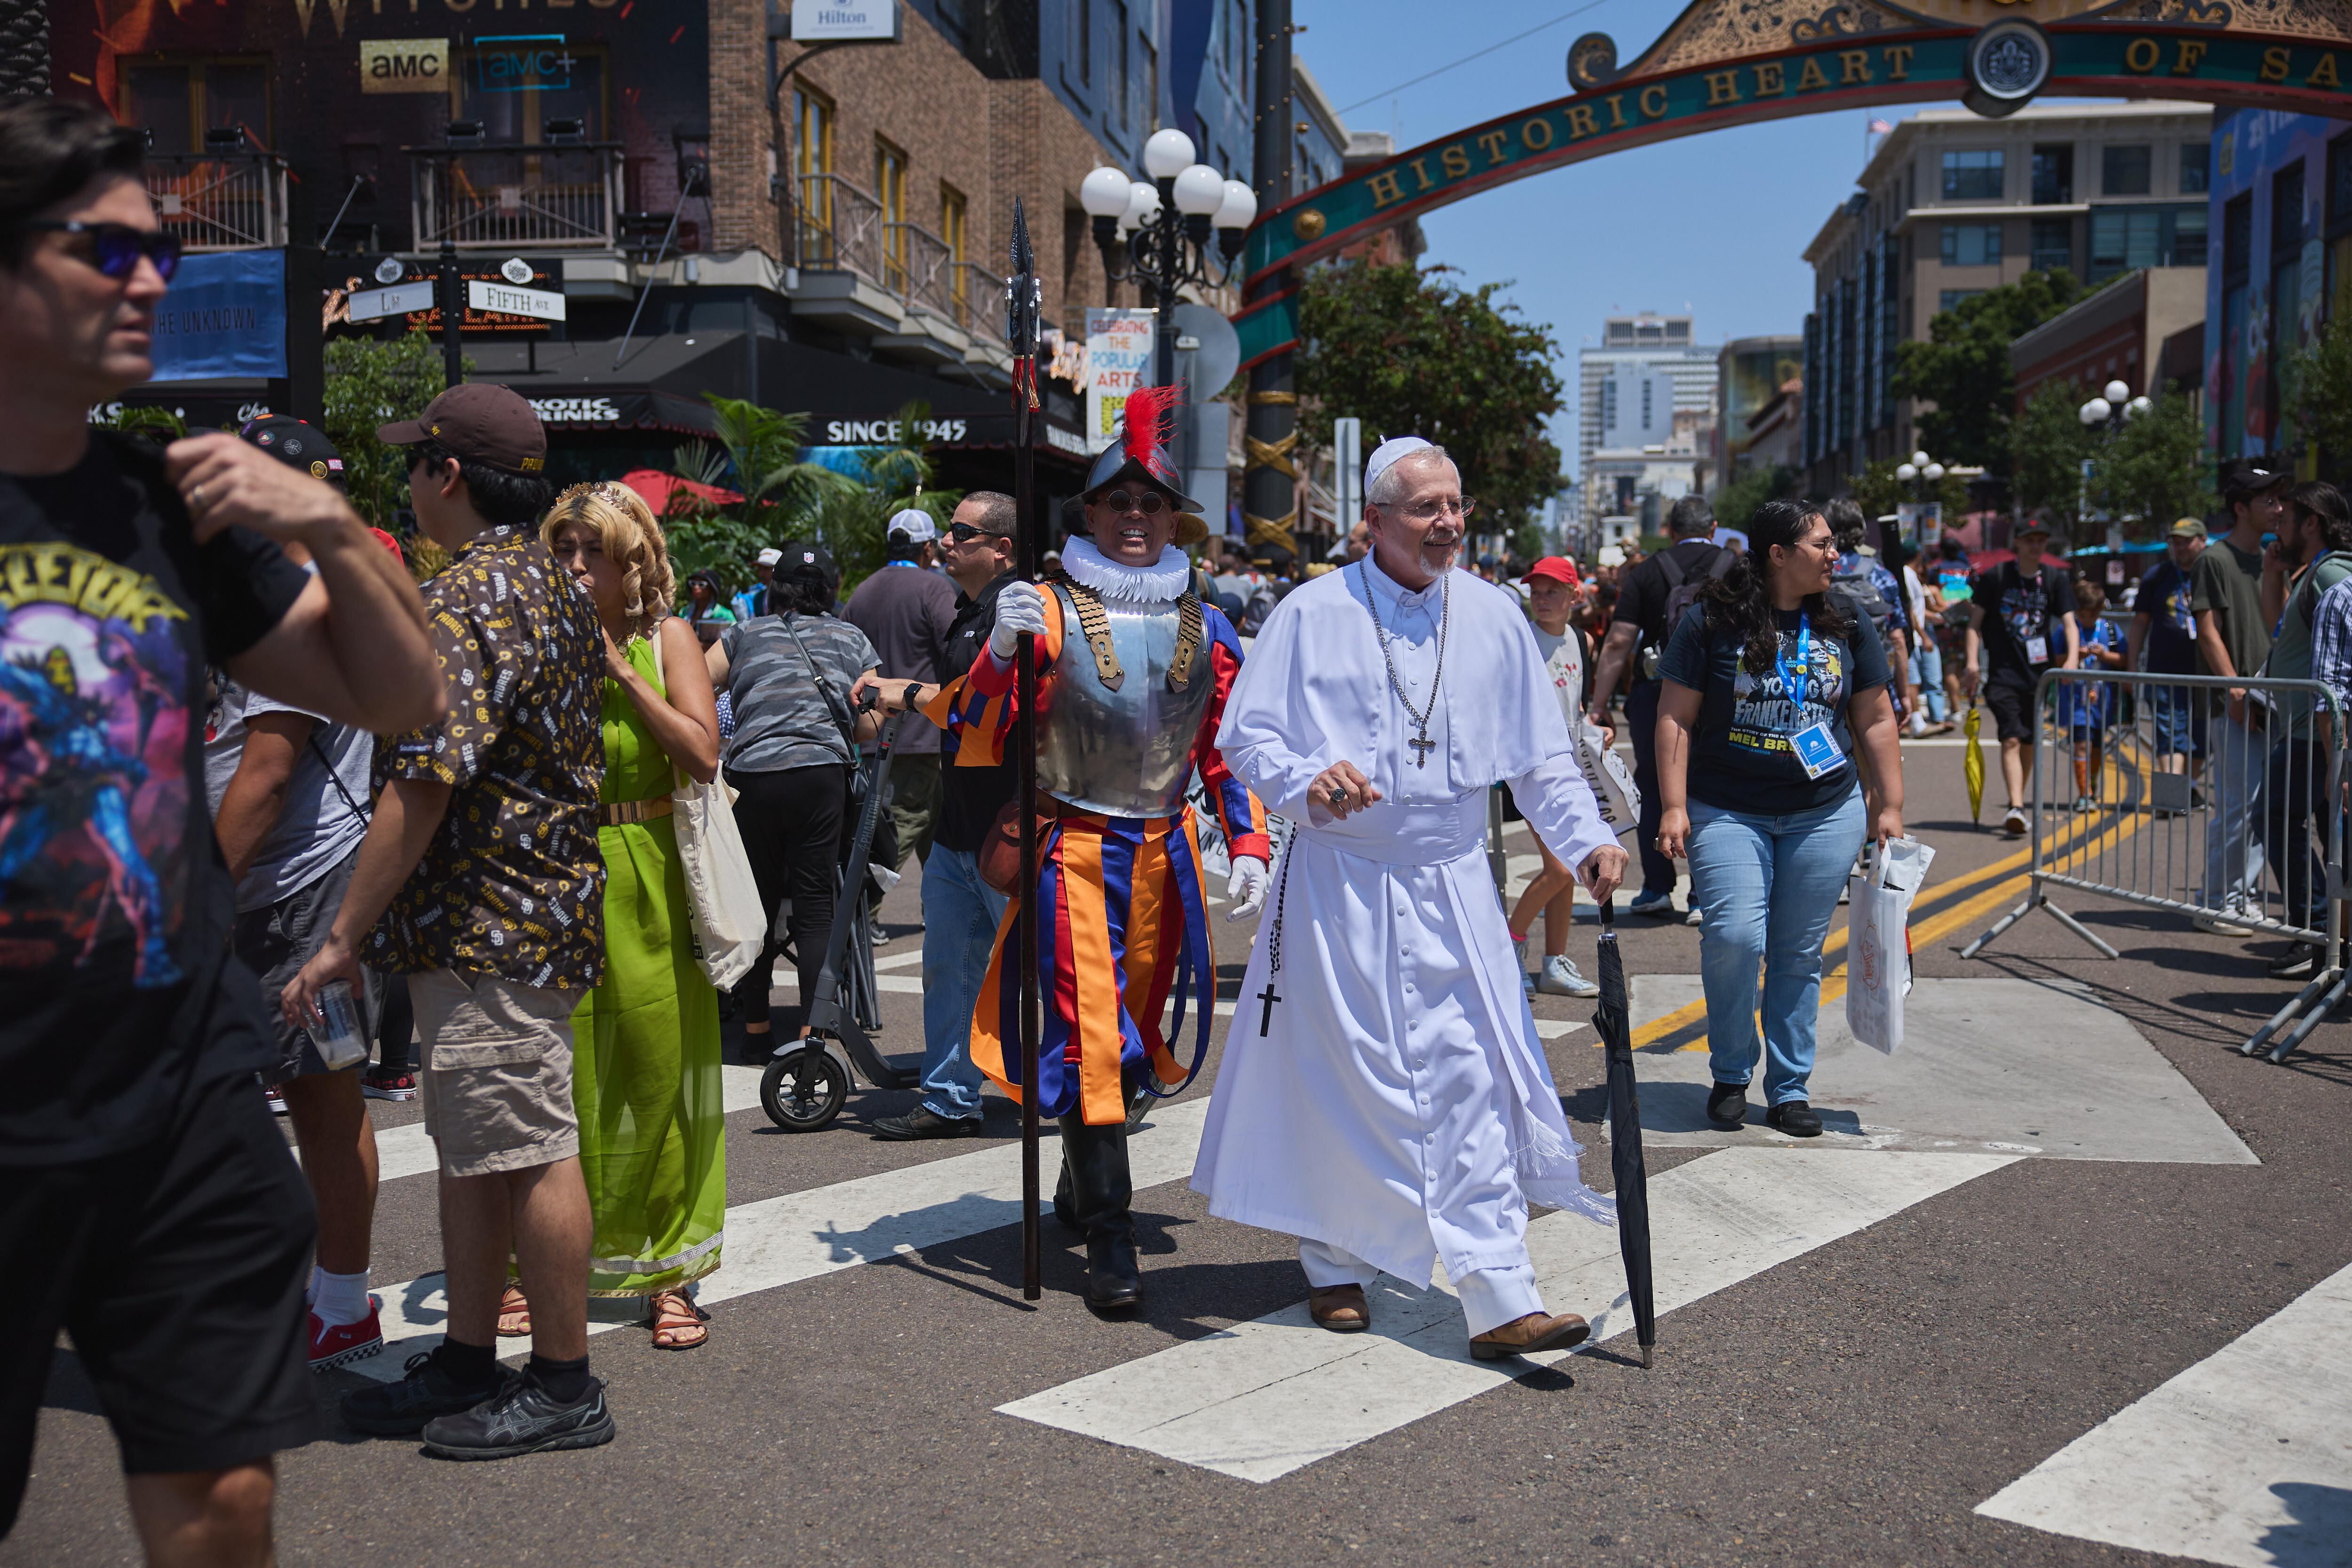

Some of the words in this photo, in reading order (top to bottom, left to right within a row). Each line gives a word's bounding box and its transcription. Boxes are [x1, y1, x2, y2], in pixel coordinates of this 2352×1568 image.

[818, 10, 866, 24] Hilton
[1366, 84, 1669, 208] HISTORIC
[1704, 45, 1914, 106] HEART
[2126, 37, 2207, 74] OF
[2260, 46, 2342, 88] SA
[487, 287, 531, 311] FIFTH
[182, 308, 255, 333] UNKNOWN
[1108, 336, 1132, 349] THE
[1092, 351, 1148, 369] POPULAR
[1097, 372, 1143, 388] ARTS
[527, 398, 612, 411] XOTIC
[535, 408, 620, 422] RINKS
[827, 420, 902, 443] SINCE
[492, 572, 507, 602] PADRES
[435, 612, 466, 638] PADRES
[493, 669, 514, 704] PADRES
[1763, 677, 1820, 699] YOG
[541, 706, 558, 736] PADRES
[1729, 732, 1759, 747] MEL
[860, 798, 880, 844] PHANTOM
[549, 824, 564, 856] PADRES
[481, 883, 510, 913] PADRES
[548, 897, 573, 927] PADRES
[522, 921, 552, 942] PADRES
